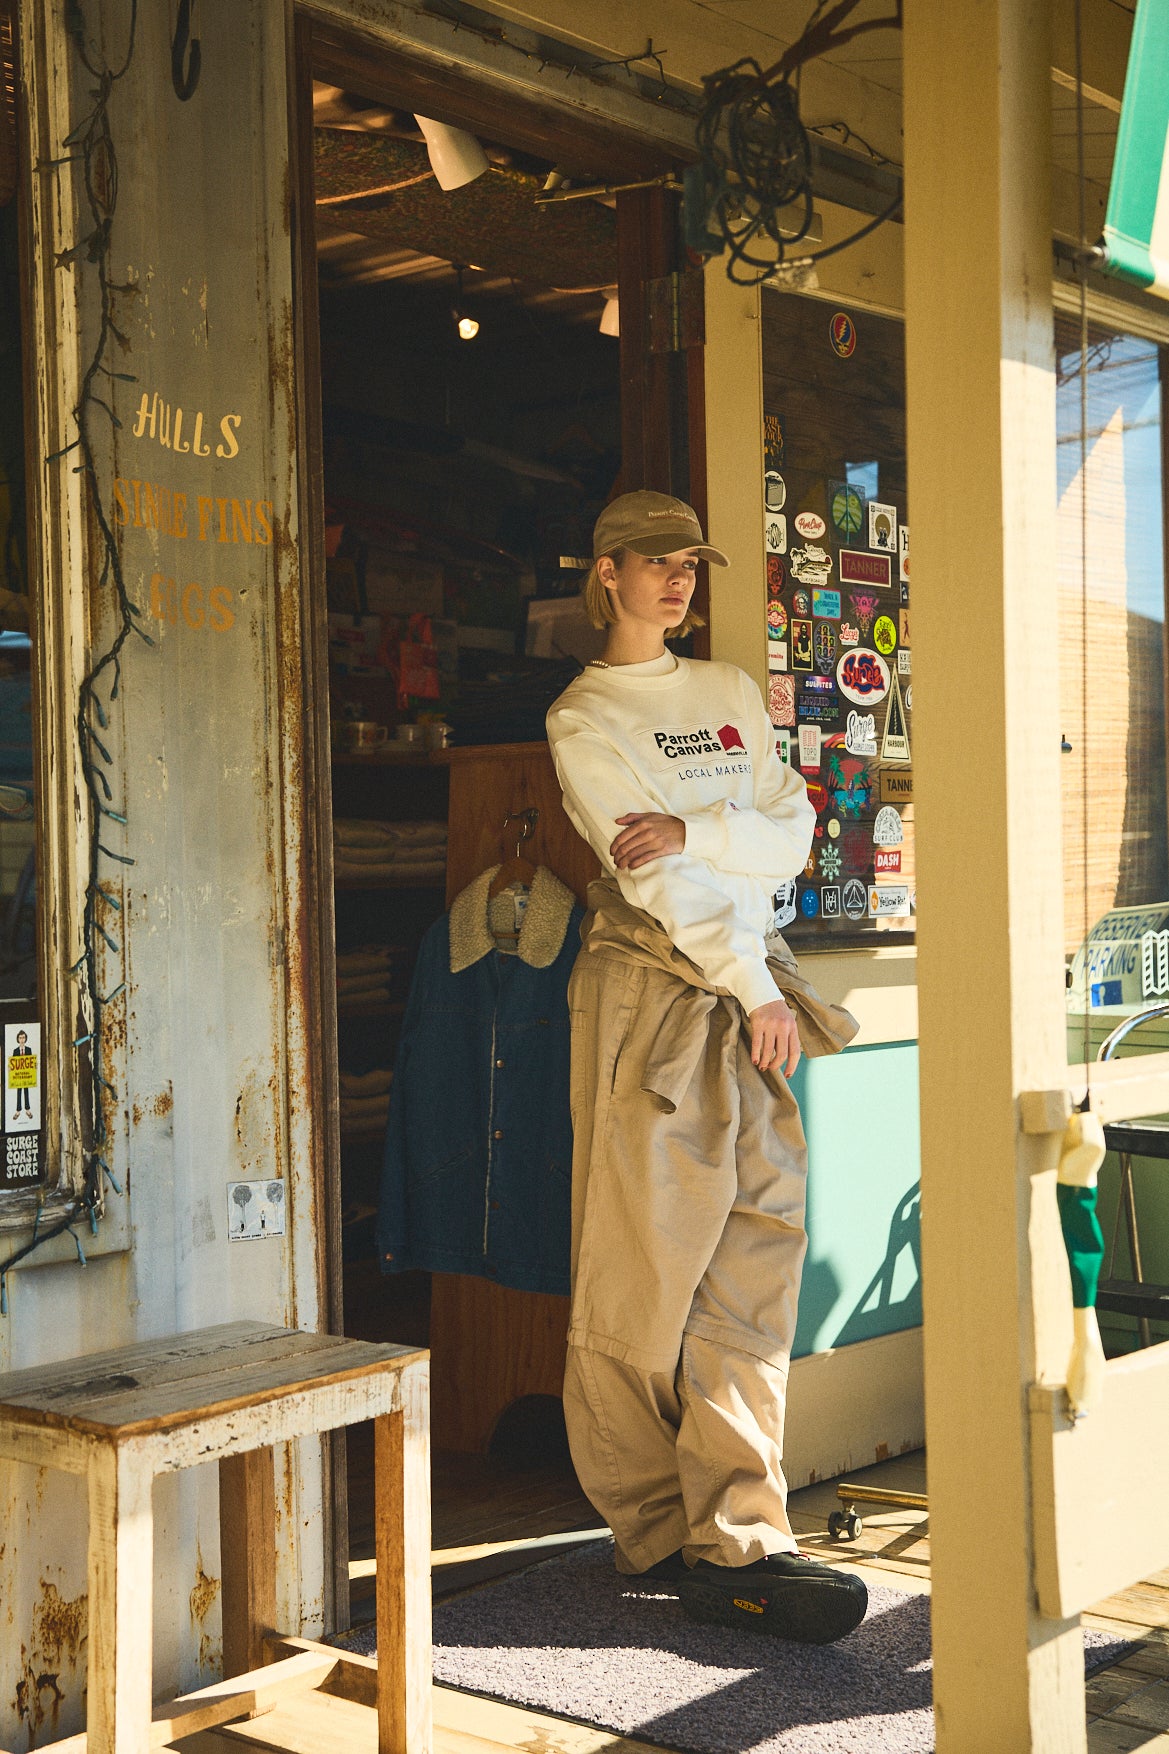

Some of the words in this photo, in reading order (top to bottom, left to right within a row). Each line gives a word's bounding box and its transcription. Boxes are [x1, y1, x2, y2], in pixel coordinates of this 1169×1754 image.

[133, 392, 241, 458] HULLS
[198, 495, 273, 545] FINS
[844, 558, 886, 578] TANNER
[151, 573, 235, 632] EGGS
[654, 729, 712, 748] Parrott
[846, 713, 873, 748] Surge
[664, 742, 721, 758] Canvas
[678, 767, 711, 780] LOCAL
[874, 834, 888, 842] SURF
[889, 834, 903, 842] CLUB
[877, 853, 899, 868] DASH
[1082, 943, 1139, 979] PARKING
[10, 1057, 34, 1071] SURGE
[6, 1135, 38, 1151] SURGE
[6, 1149, 38, 1164] COAST
[6, 1162, 38, 1179] STORE
